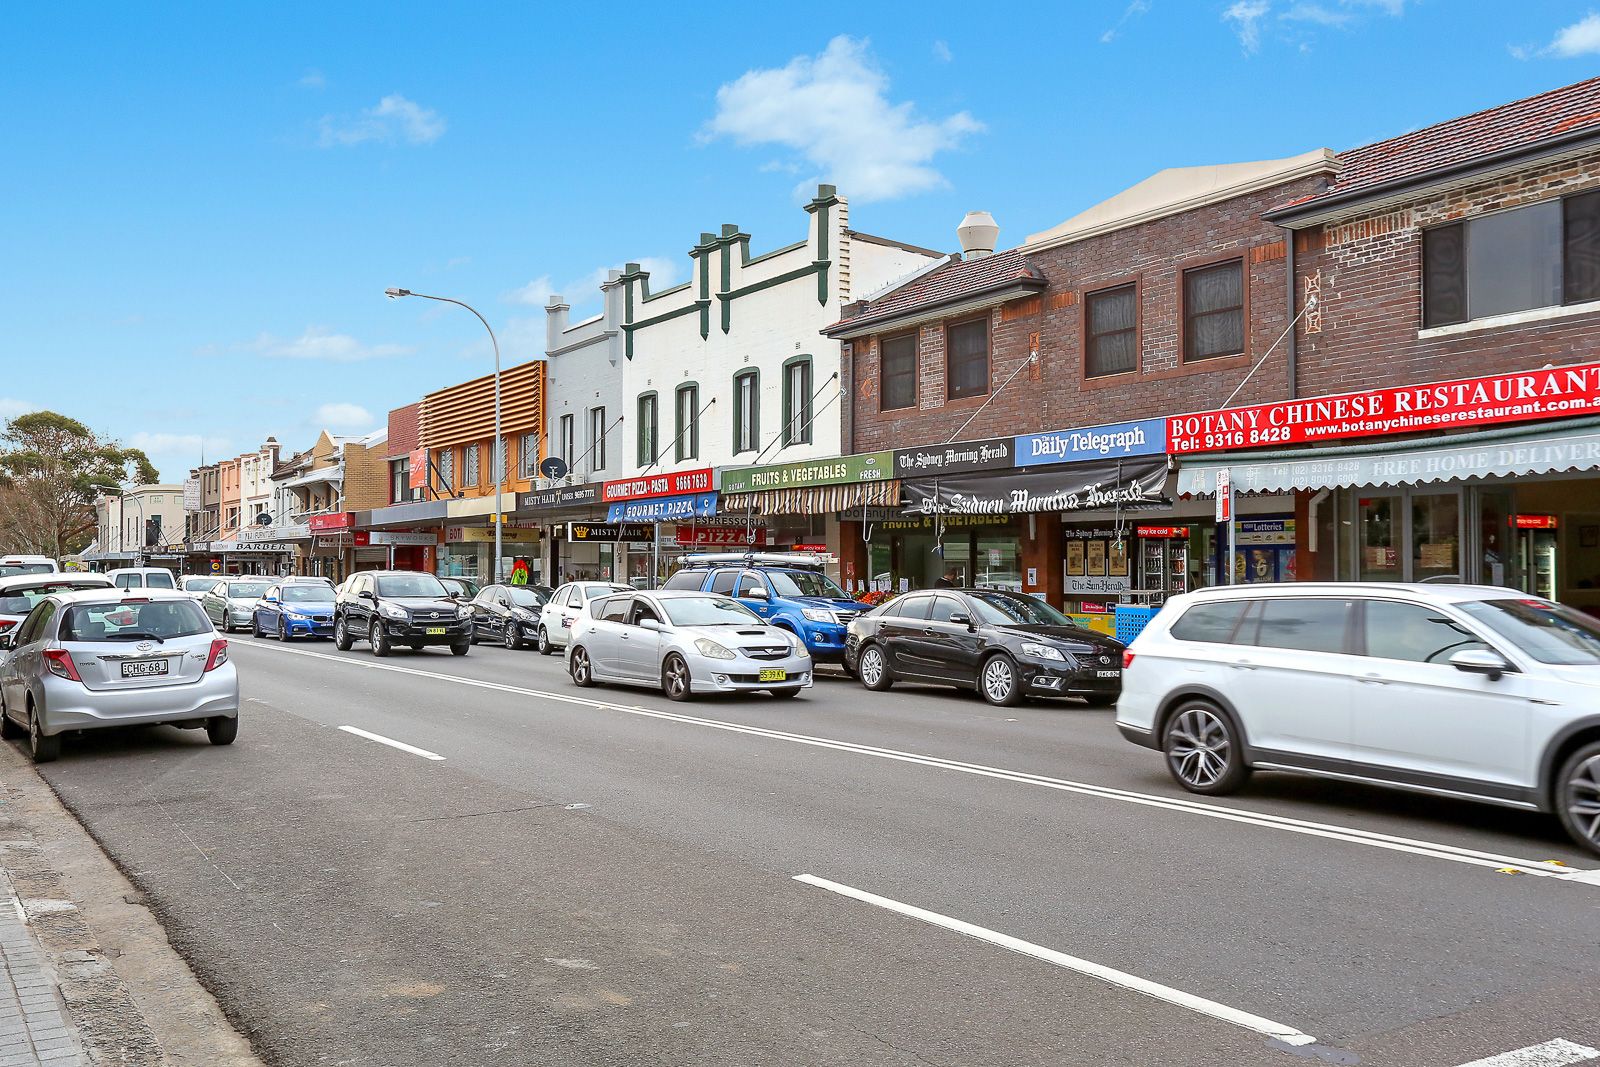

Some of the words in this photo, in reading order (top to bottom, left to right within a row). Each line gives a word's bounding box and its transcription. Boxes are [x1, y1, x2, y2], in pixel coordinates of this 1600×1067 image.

[1171, 409, 1262, 437] BOTANY
[1269, 393, 1384, 426] CHINESE
[1394, 367, 1600, 413] RESTAURANT
[1031, 437, 1069, 458] Daily
[1069, 426, 1145, 454] Telegraph
[1171, 438, 1200, 451] Tel:
[1205, 431, 1244, 448] 9316
[1250, 426, 1291, 443] 8428
[900, 455, 914, 470] The
[914, 451, 943, 469] Sydney
[945, 448, 979, 467] Morning
[980, 443, 1008, 463] Herald
[1372, 459, 1421, 477] FREE
[1427, 453, 1489, 472] HOME
[752, 471, 780, 486] FRUITS
[782, 470, 789, 483] &
[791, 464, 847, 482] VEGETABLES
[860, 469, 881, 480] FRESH
[606, 482, 631, 498] GOURMET
[632, 480, 647, 495] PIZZA
[651, 478, 669, 493] PASTA
[728, 482, 745, 491] BOTANY
[524, 495, 540, 506] MISTY
[541, 493, 555, 504] HAIR
[626, 501, 664, 517] GOURMET
[668, 501, 694, 515] PIZZA
[695, 517, 766, 526] ESPRESSORIA
[1253, 523, 1283, 531] Lotteries
[590, 528, 618, 536] MISTY
[697, 532, 748, 543] PIZZA
[236, 543, 286, 551] BARBER
[1071, 580, 1085, 591] The
[1085, 580, 1123, 593] Sun-Herald
